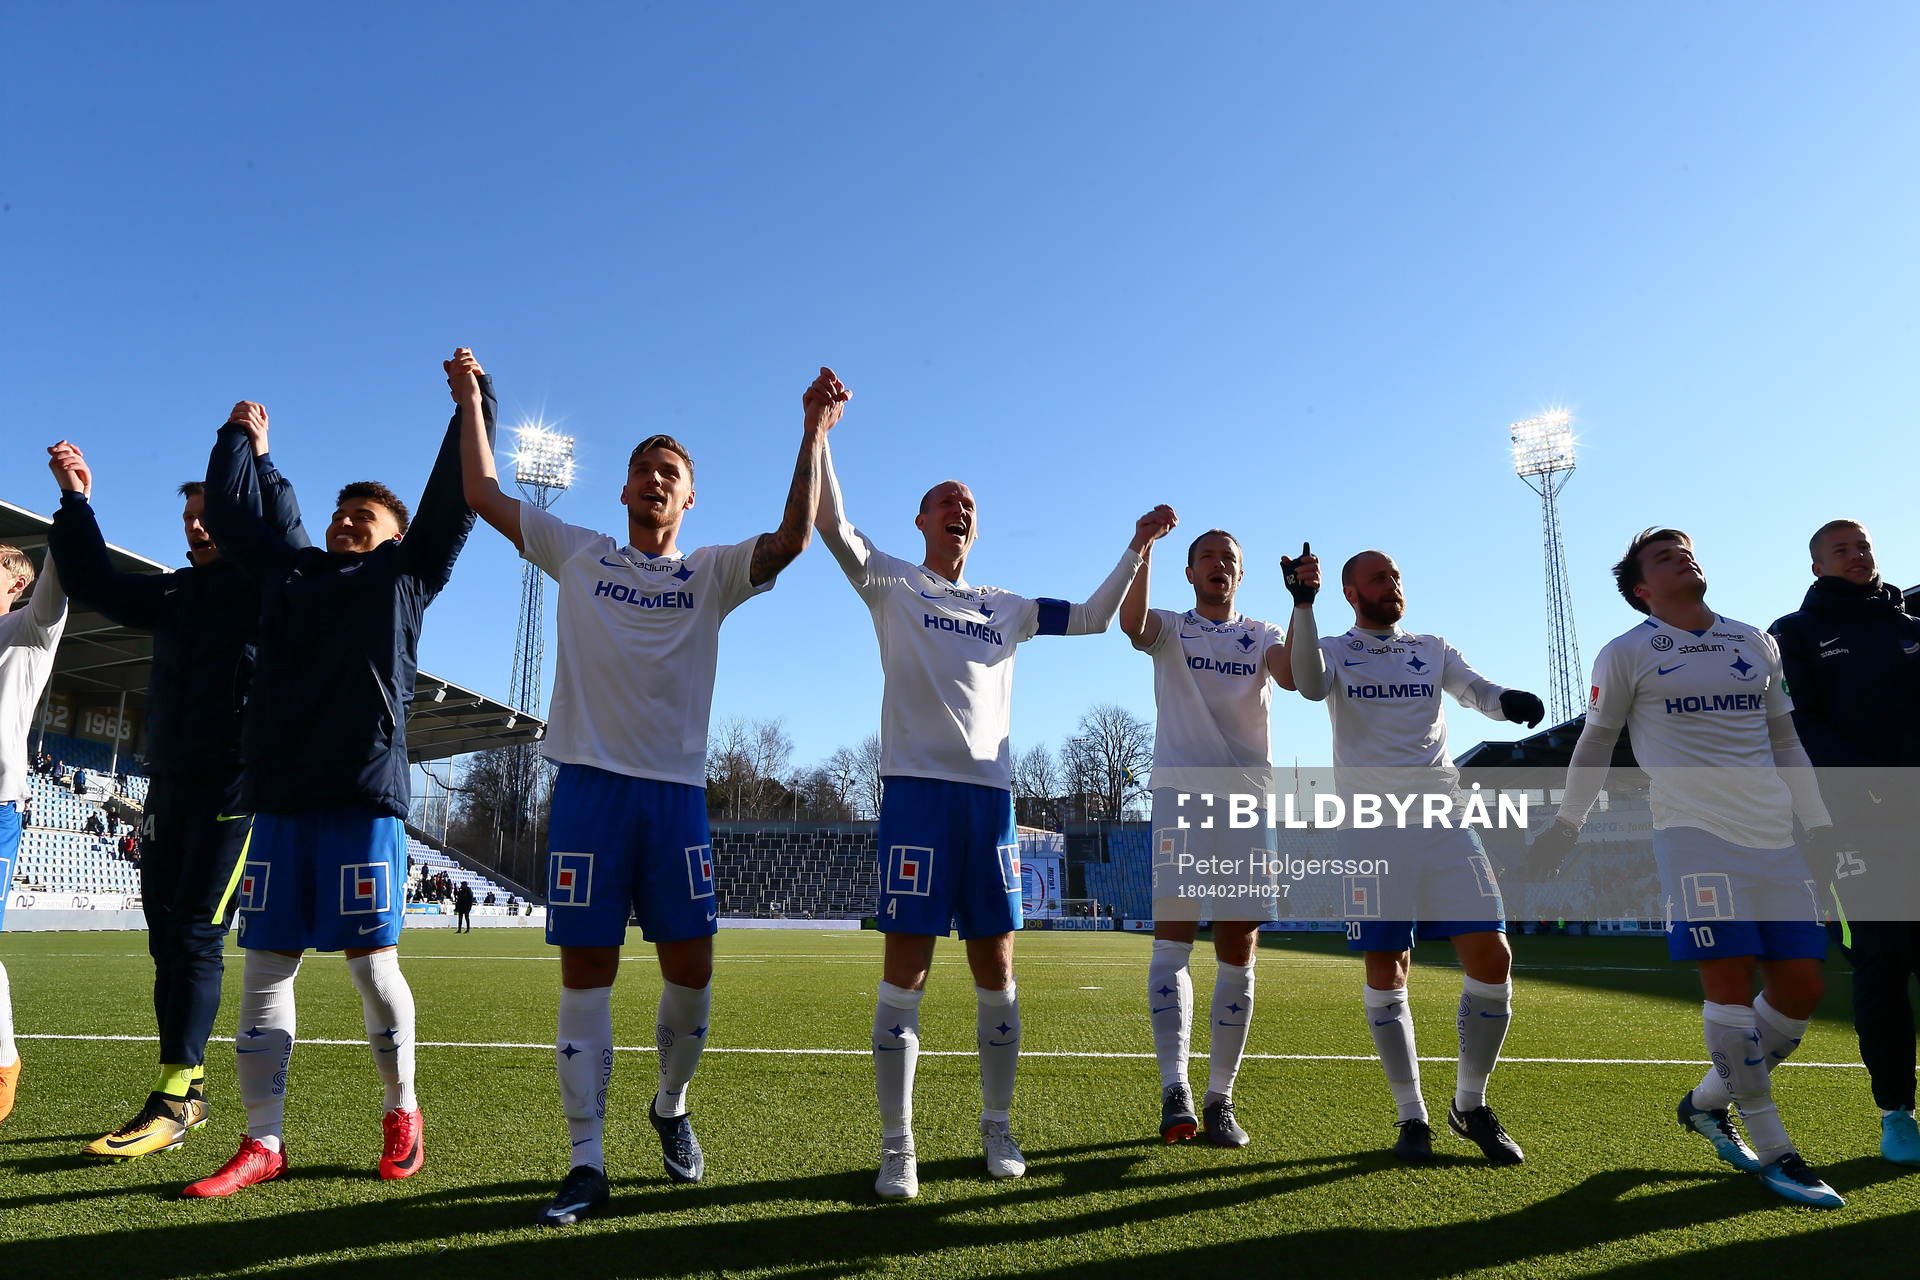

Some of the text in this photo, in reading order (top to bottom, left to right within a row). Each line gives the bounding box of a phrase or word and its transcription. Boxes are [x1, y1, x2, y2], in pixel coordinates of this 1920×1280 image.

[595, 580, 694, 609] HOLMEN
[924, 614, 1003, 646] HOLMEN
[1678, 643, 1725, 654] stadium
[1348, 684, 1435, 699] HOLMEN
[1665, 694, 1762, 714] HOLMEN
[84, 711, 132, 740] 1963
[886, 898, 897, 920] 4
[1689, 926, 1716, 948] 10
